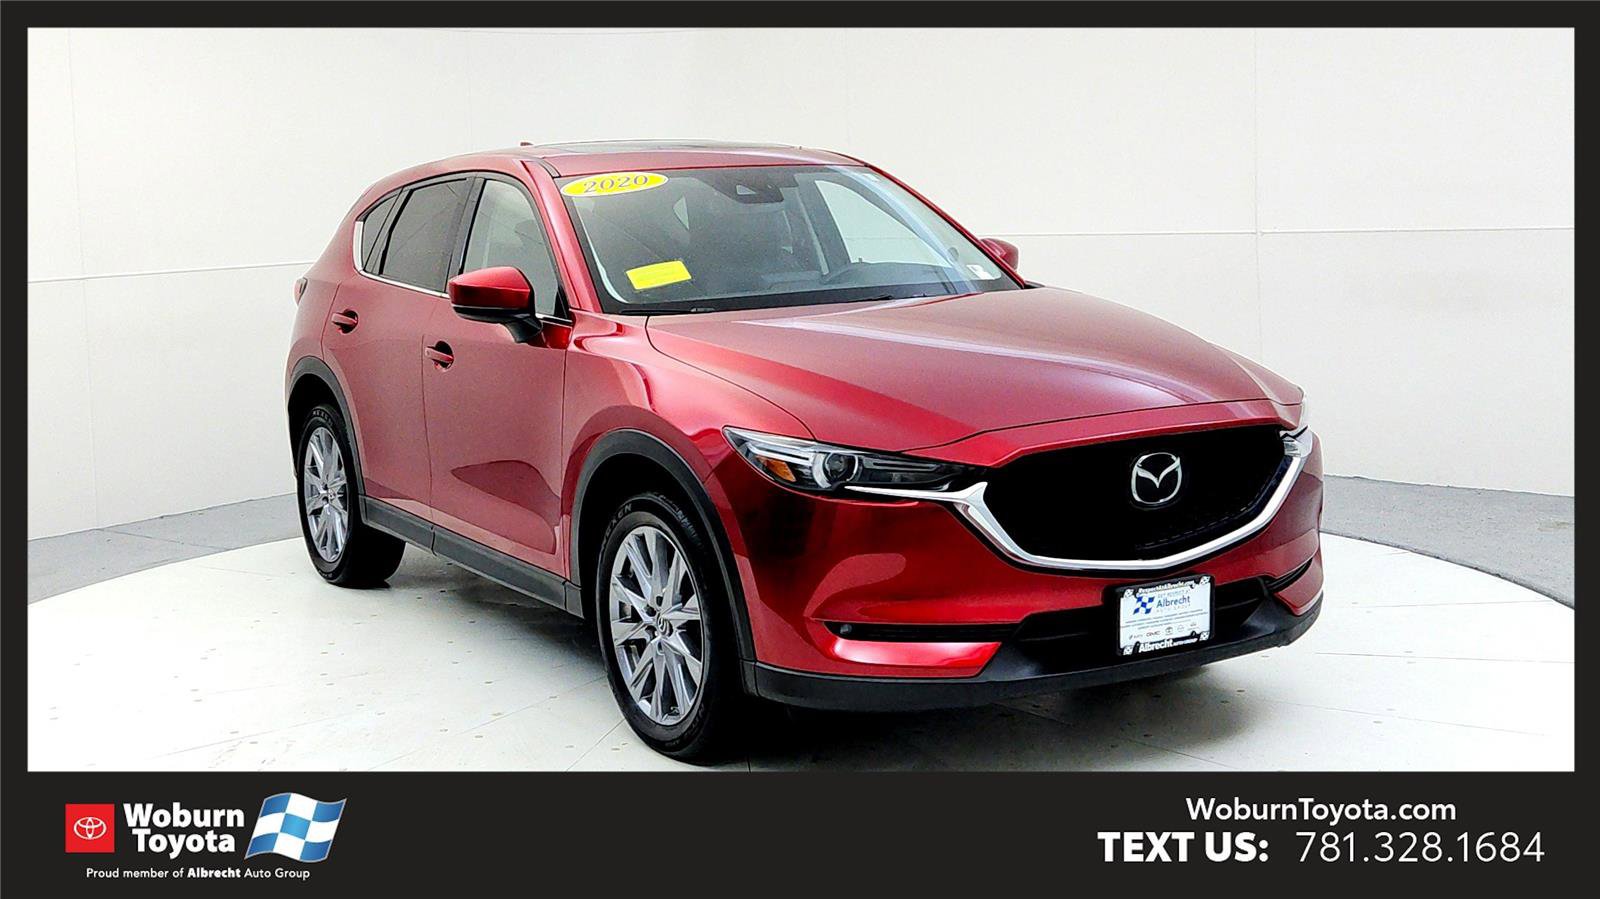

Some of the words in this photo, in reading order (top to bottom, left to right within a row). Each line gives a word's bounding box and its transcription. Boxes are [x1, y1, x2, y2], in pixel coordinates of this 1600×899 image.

[583, 175, 648, 193] 2020
[1156, 596, 1190, 608] Albrecht
[1138, 639, 1174, 653] Albrecht
